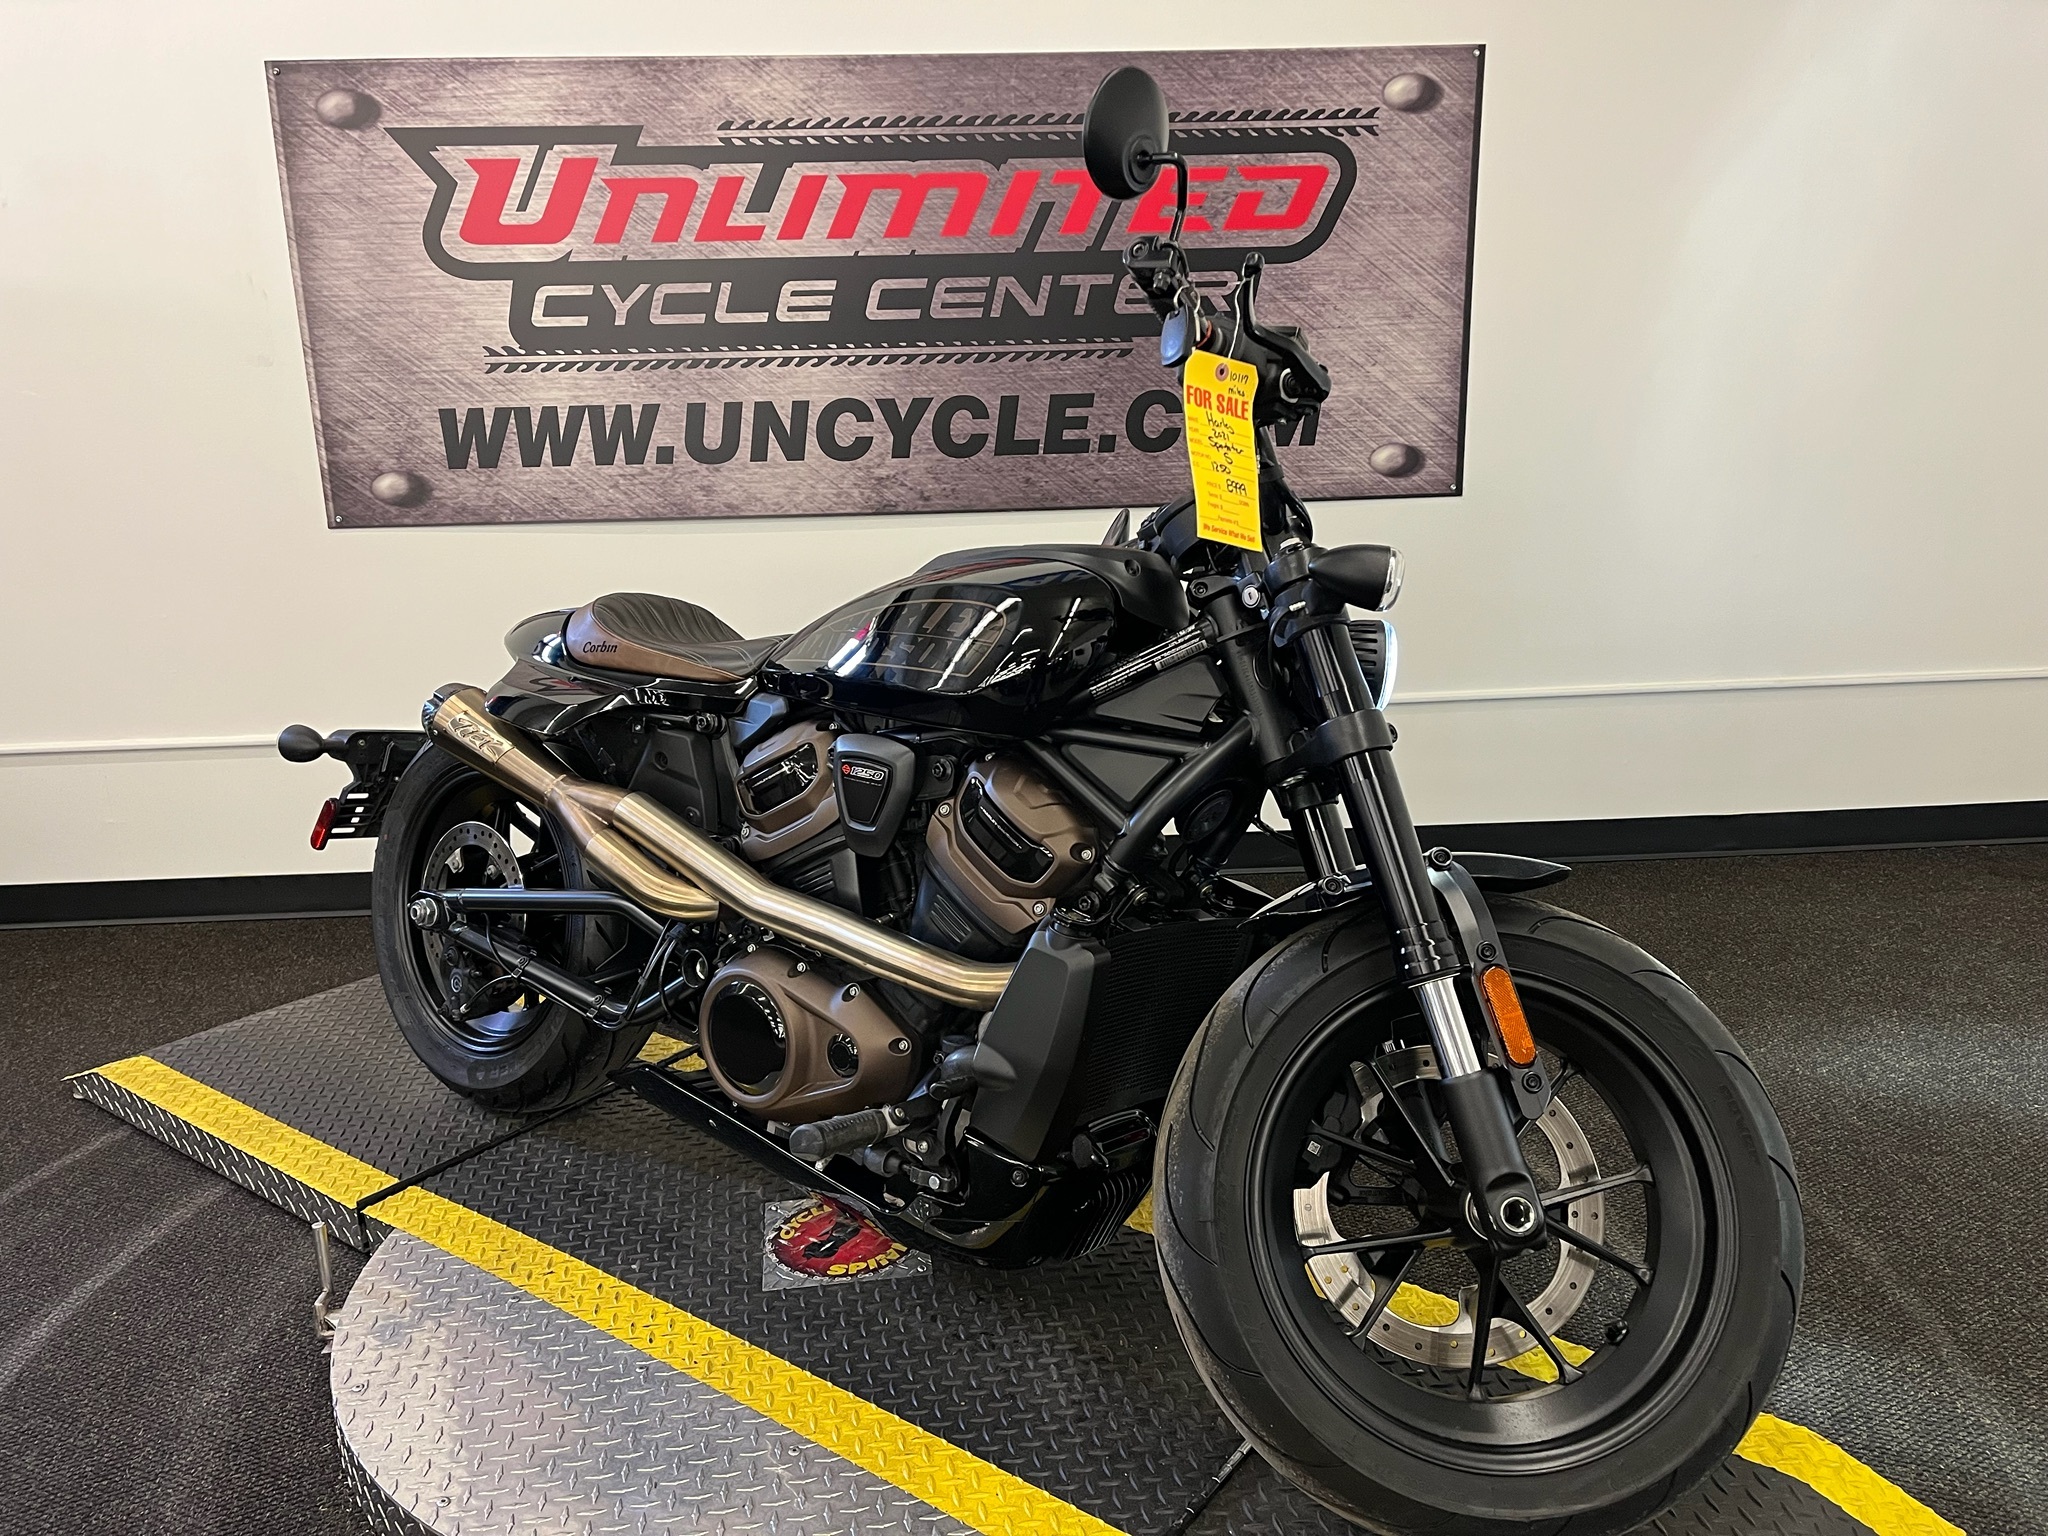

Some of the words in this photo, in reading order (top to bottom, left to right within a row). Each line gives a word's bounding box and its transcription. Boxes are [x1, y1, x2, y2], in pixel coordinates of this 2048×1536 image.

[531, 280, 838, 327] CYCLE
[1186, 384, 1212, 410] FOR
[1216, 393, 1249, 421] SALE
[1206, 410, 1235, 435] Harley
[582, 640, 618, 654] Corbin
